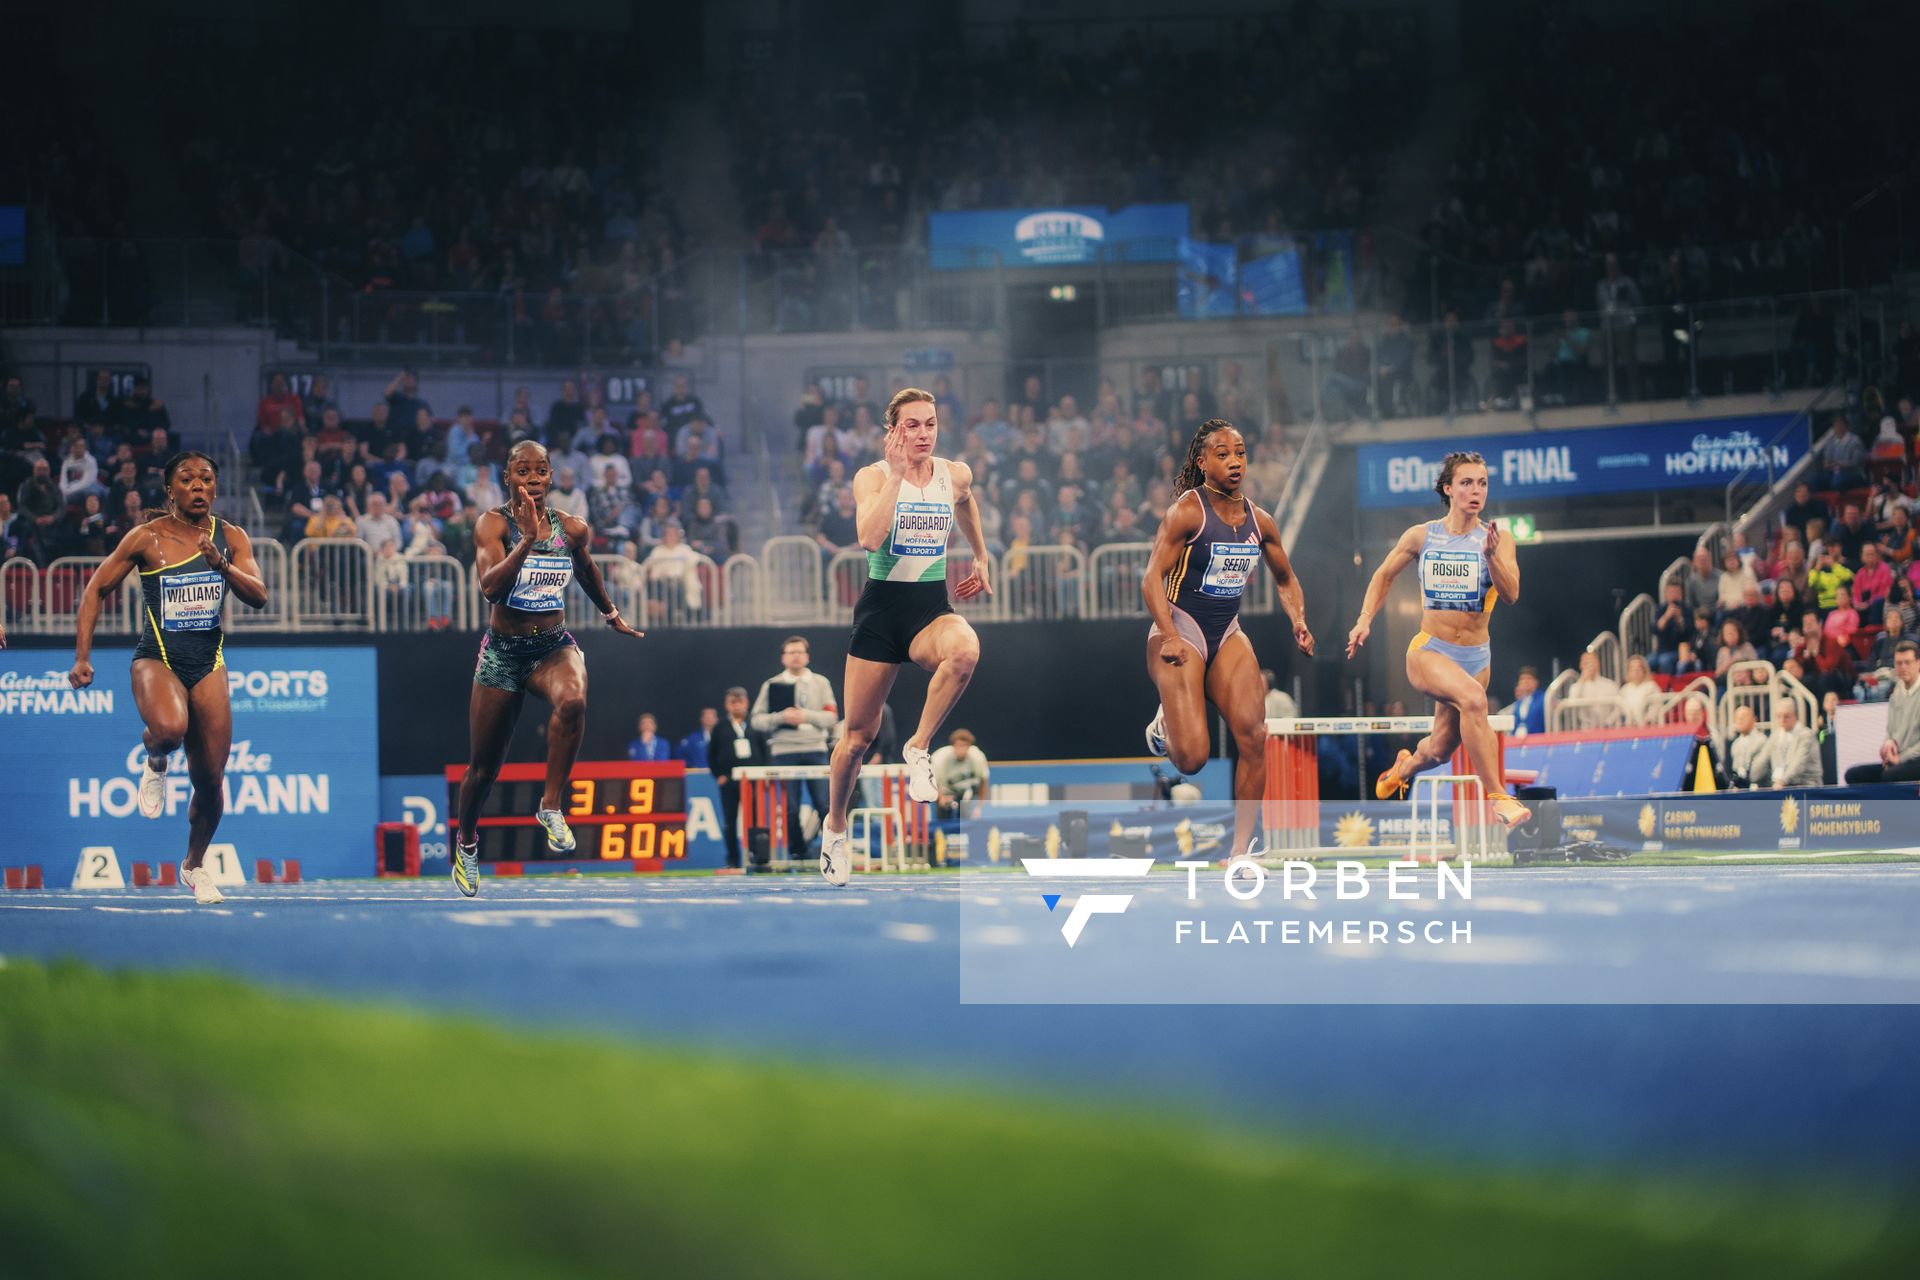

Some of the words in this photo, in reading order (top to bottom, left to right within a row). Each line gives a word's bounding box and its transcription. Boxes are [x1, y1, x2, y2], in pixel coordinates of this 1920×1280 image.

[1502, 446, 1577, 486] FINAL
[900, 515, 949, 530] BURGHARDT
[1433, 563, 1469, 576] ROSIUS
[529, 572, 566, 586] FORBES
[167, 586, 221, 602] WILLIAMS
[1664, 810, 1698, 825] CASINO
[1809, 803, 1862, 819] SPIELBANK
[1809, 820, 1881, 836] HOHENSYBURG
[91, 855, 110, 879] 2
[215, 852, 226, 876] 1
